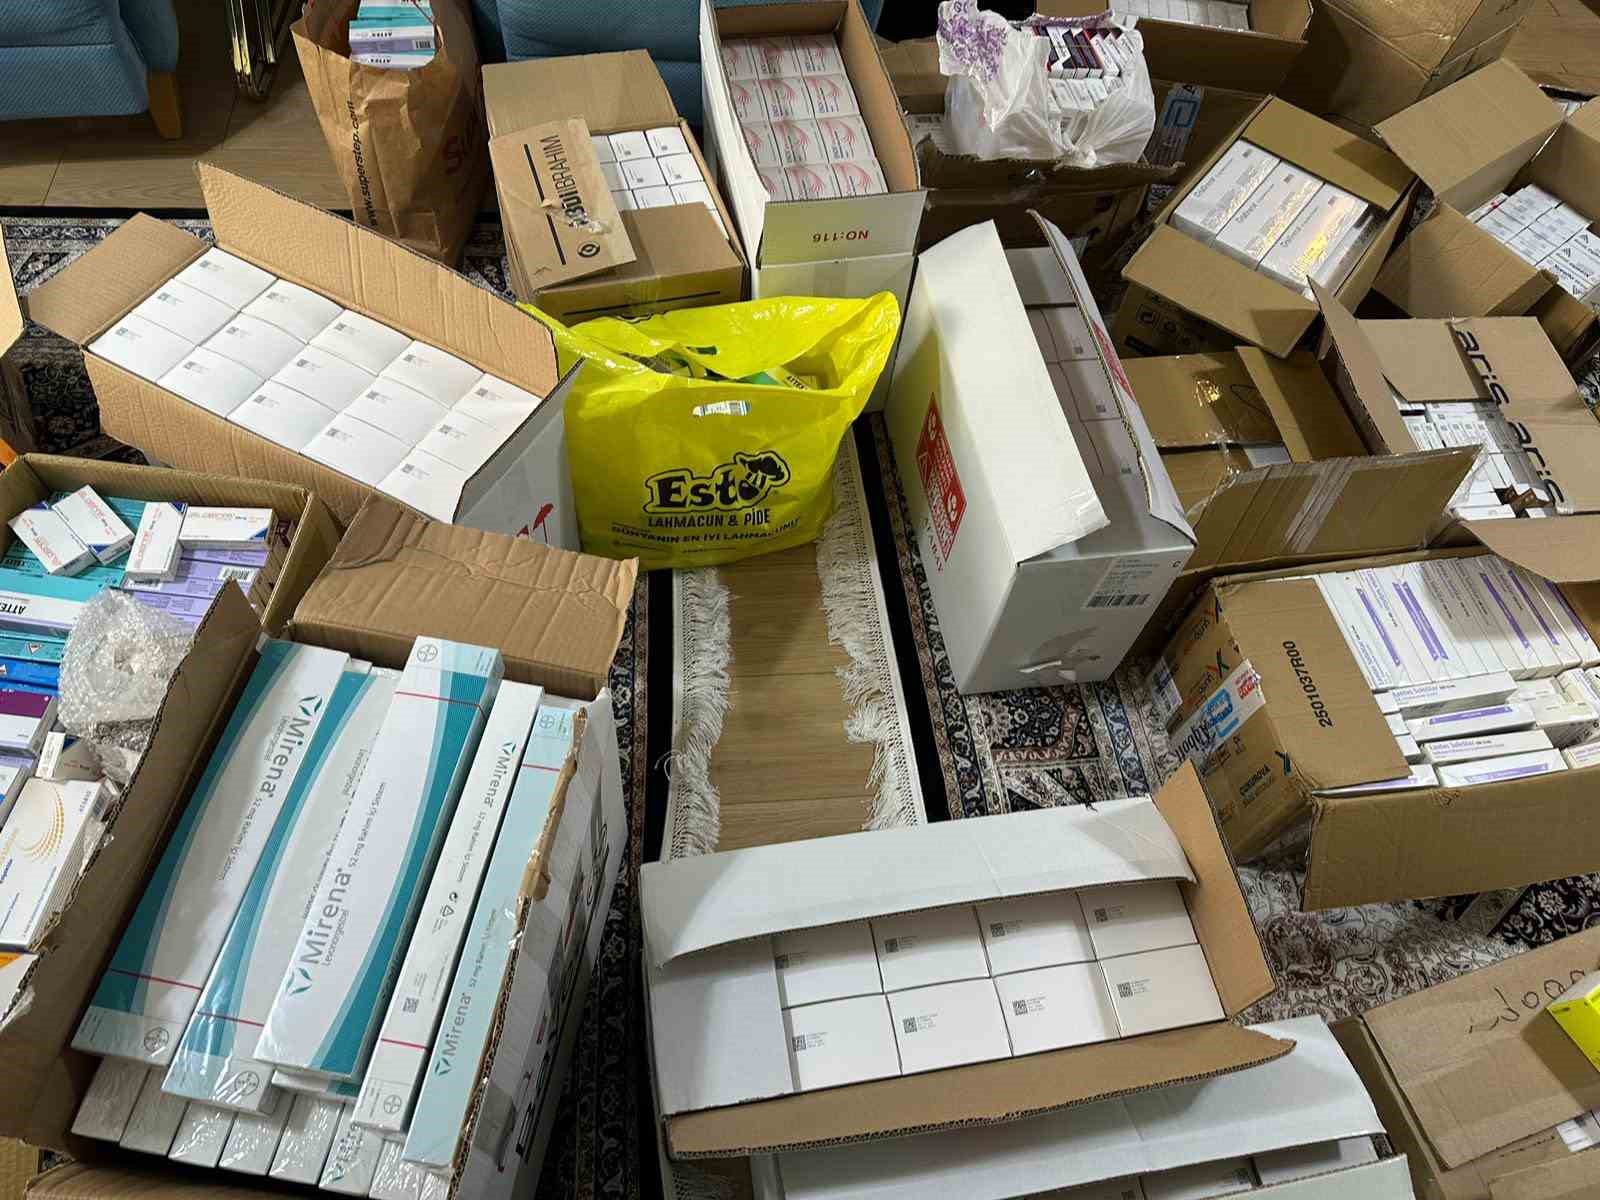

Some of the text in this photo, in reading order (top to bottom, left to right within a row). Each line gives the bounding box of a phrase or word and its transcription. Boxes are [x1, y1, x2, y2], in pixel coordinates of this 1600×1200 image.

[648, 511, 724, 528] LAHMACUN
[727, 513, 739, 527] &
[0, 601, 26, 615] ATTE
[303, 867, 352, 965] Mirena
[443, 995, 472, 1057] Mirena
